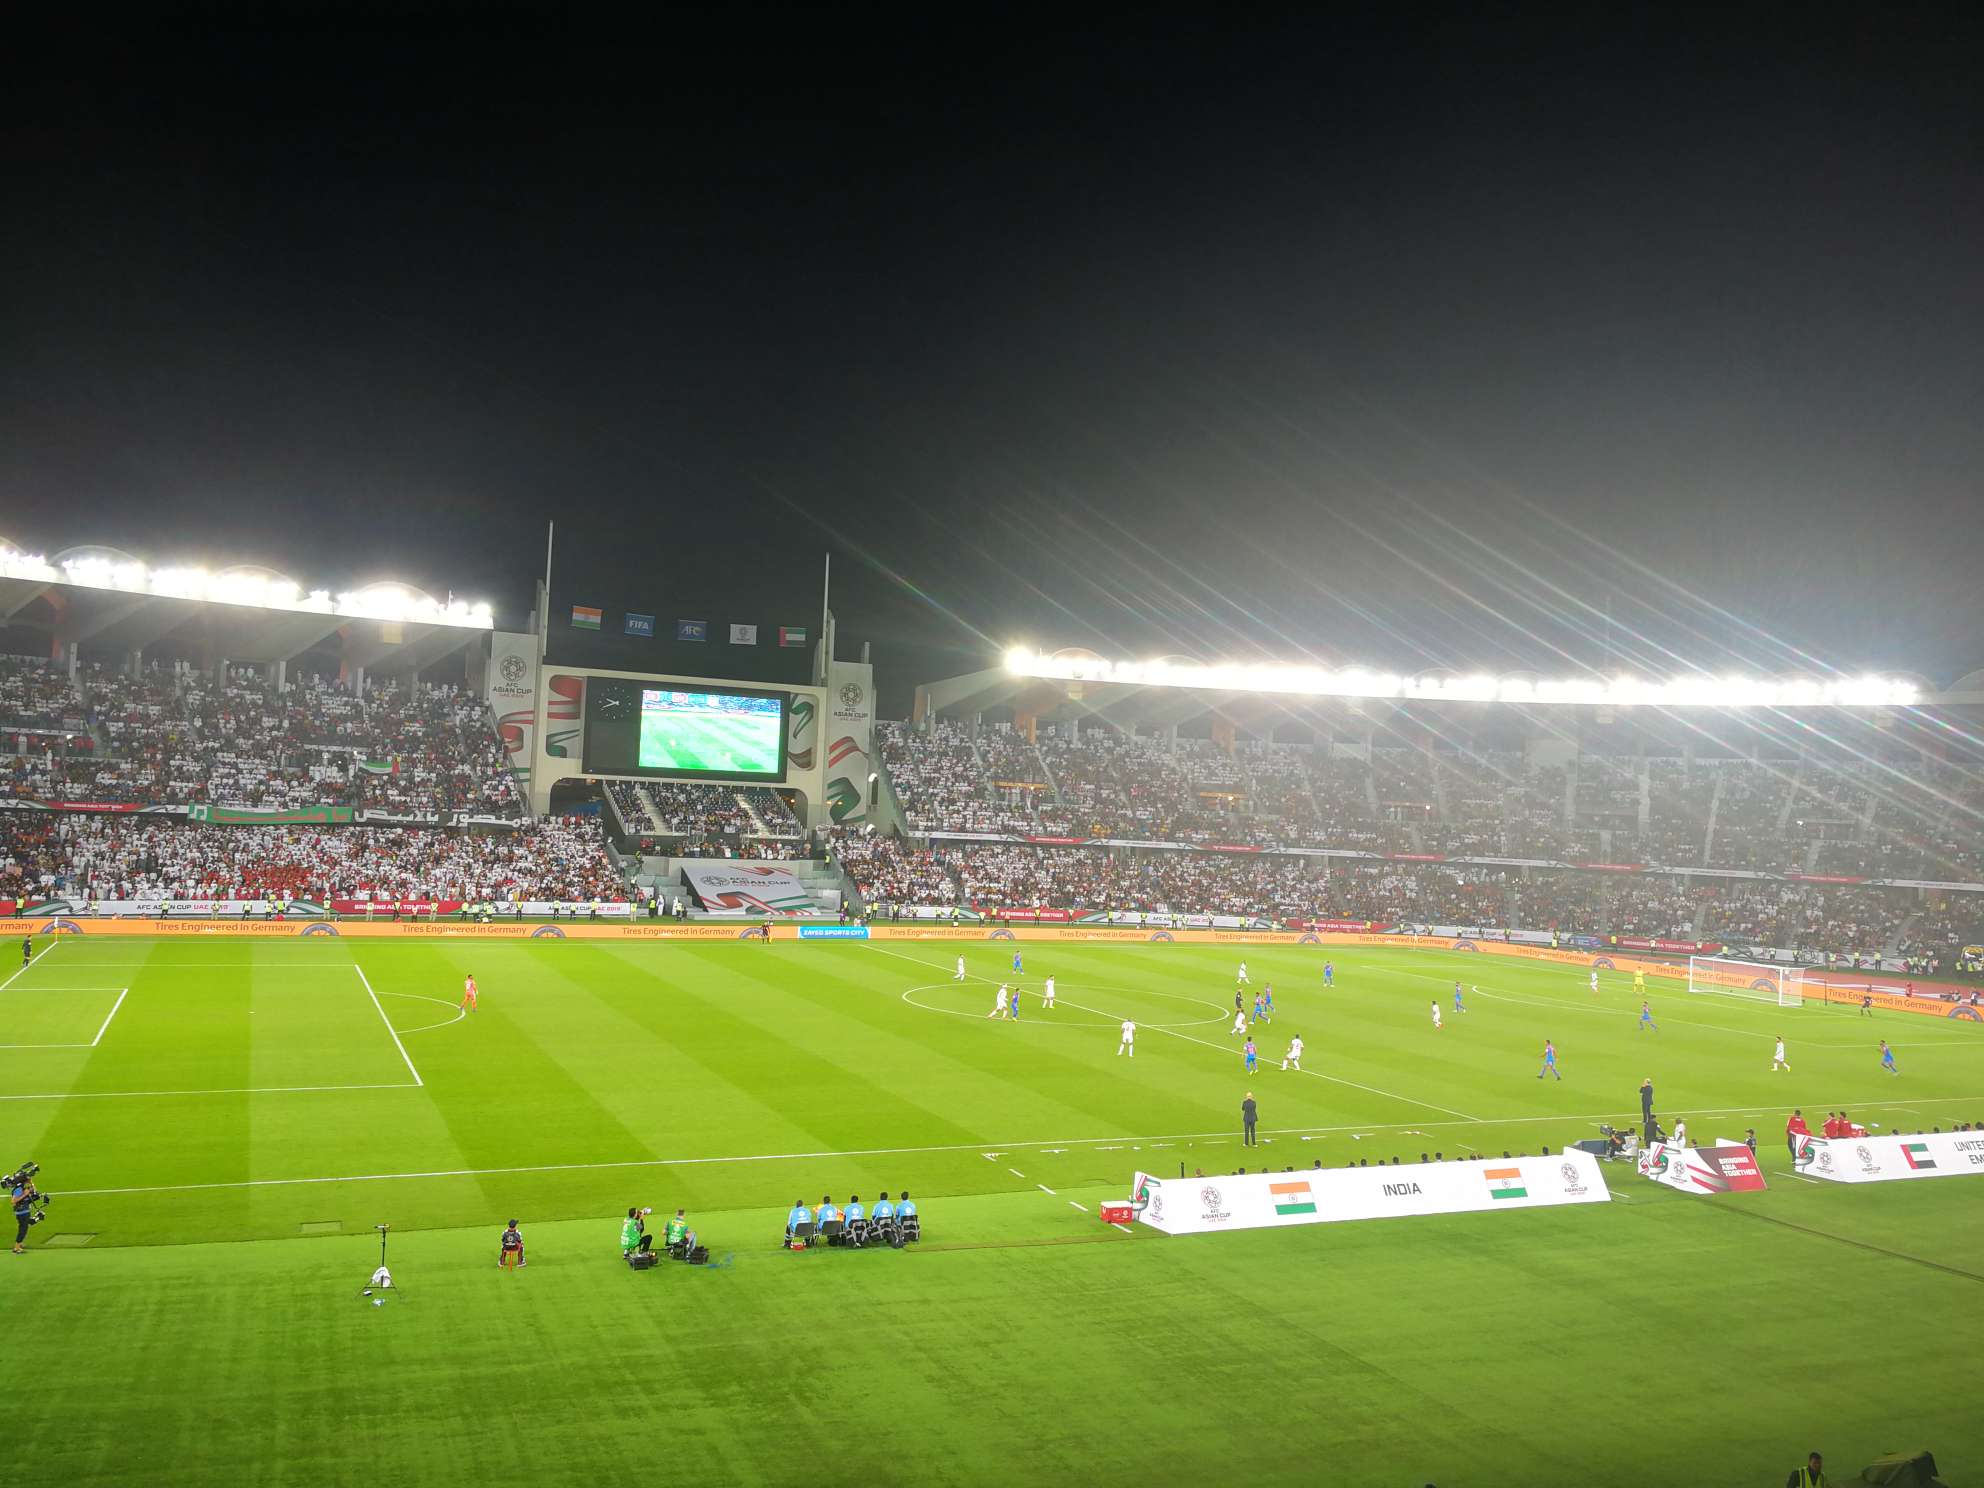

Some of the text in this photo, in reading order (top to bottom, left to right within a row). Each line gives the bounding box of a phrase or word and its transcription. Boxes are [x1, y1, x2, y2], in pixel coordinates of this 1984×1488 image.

[629, 619, 649, 630] FIFA
[155, 922, 180, 931] Tires
[181, 922, 239, 933] Engineered
[251, 923, 296, 933] Germany
[402, 924, 424, 932] Tires
[426, 924, 476, 935] Engineered
[487, 926, 527, 935] Germany
[643, 927, 689, 936] Engineered
[700, 927, 736, 936] Germany
[889, 928, 906, 936] Tires
[907, 928, 946, 937] Engineered
[954, 929, 986, 938] Germany
[1829, 988, 1847, 997] Tires
[1848, 991, 1894, 1005] Engered
[1904, 1000, 1943, 1013] Germany
[1723, 1168, 1757, 1177] TOGETHER
[1382, 1182, 1423, 1197] INDIA
